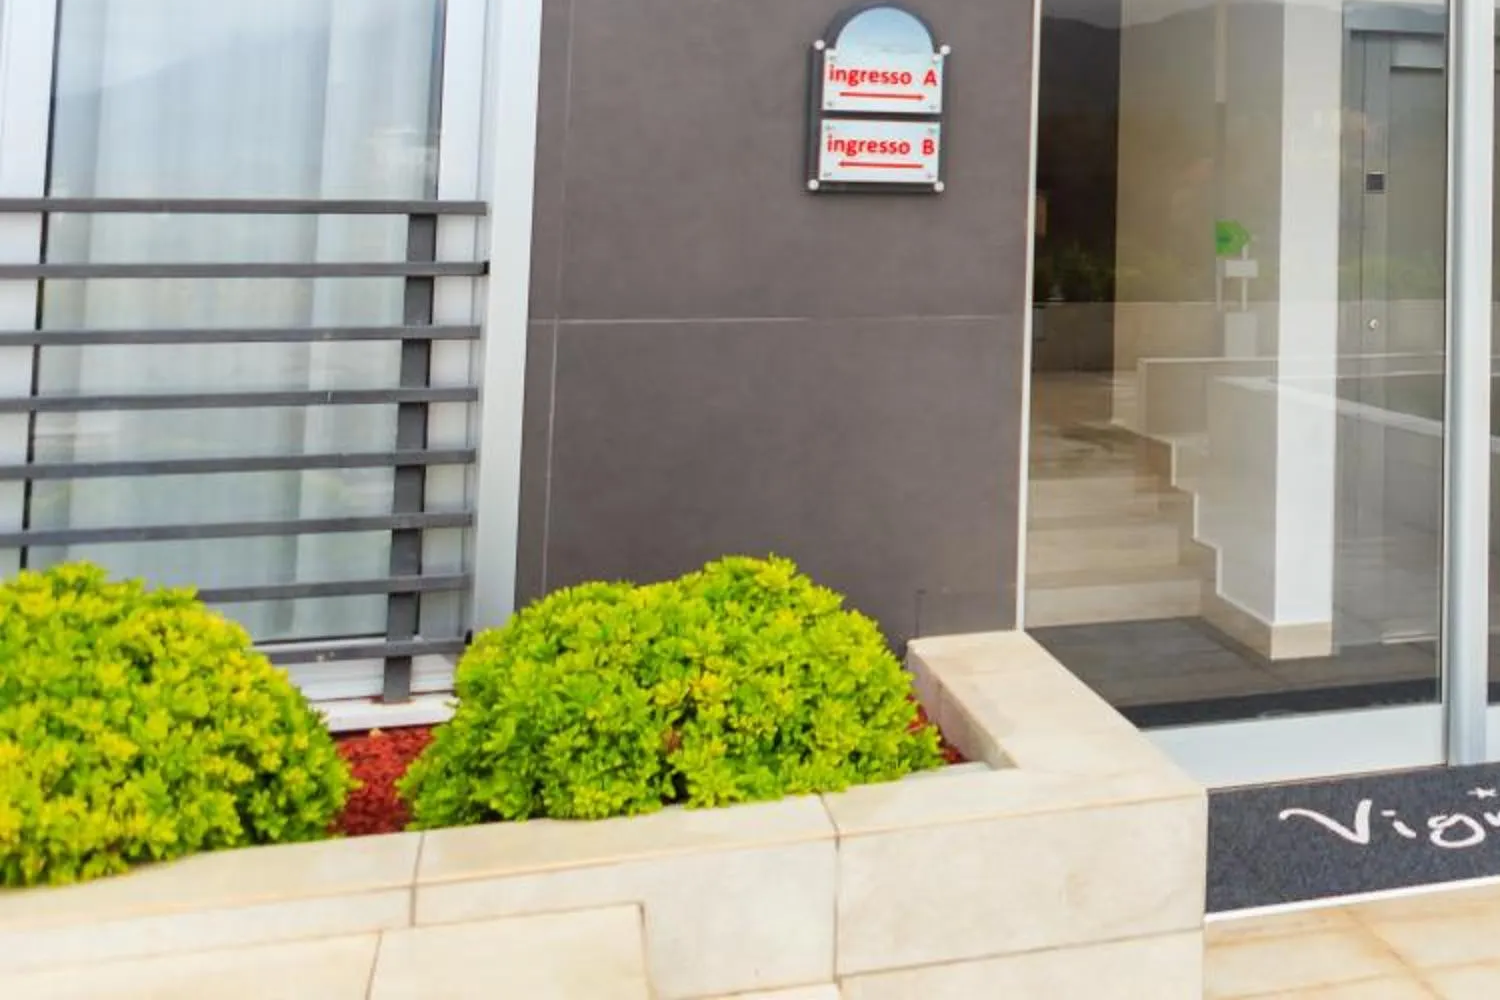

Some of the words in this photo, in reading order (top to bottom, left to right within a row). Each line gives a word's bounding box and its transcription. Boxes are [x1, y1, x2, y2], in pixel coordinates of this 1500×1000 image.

[829, 64, 912, 87] ingresso
[923, 69, 937, 86] A
[827, 134, 910, 157] ingresso
[922, 138, 935, 156] B
